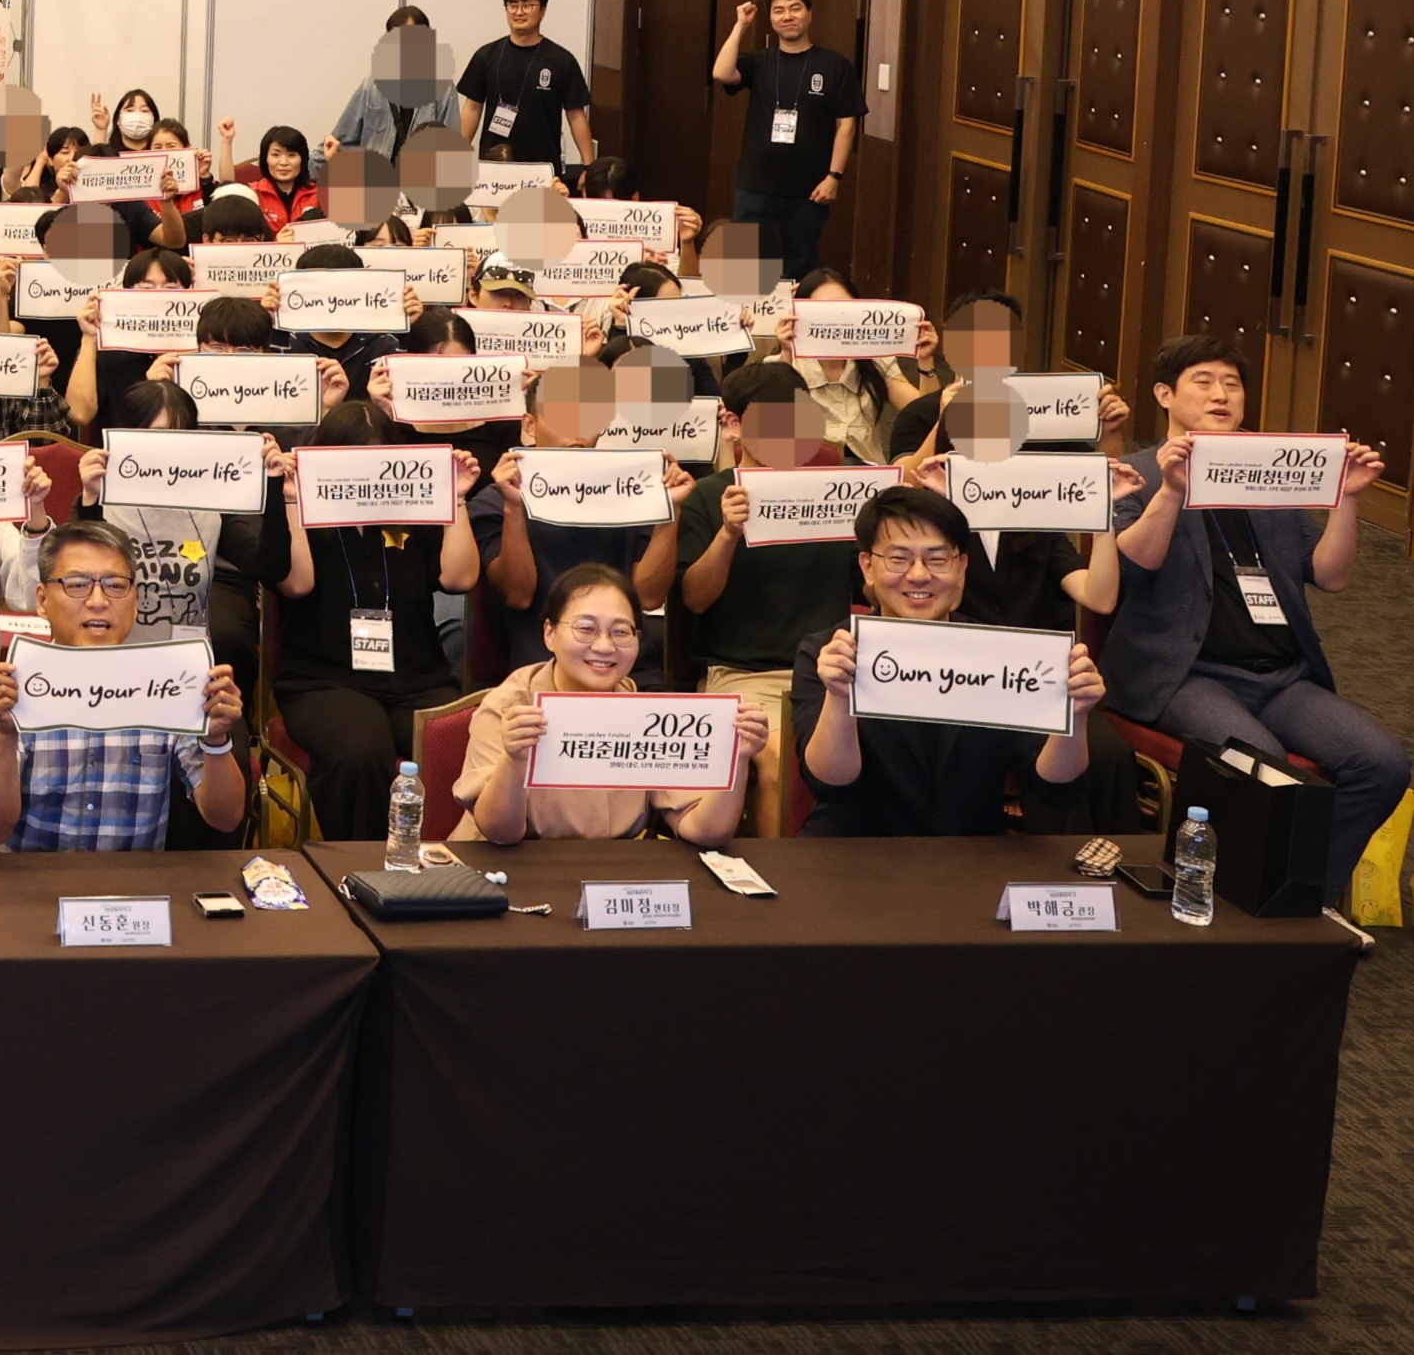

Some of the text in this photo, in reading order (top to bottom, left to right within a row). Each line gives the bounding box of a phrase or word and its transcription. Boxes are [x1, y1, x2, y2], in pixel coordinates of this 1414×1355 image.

[861, 310, 907, 326] 2026
[808, 327, 905, 341] 자립준비청년의 날
[462, 365, 511, 384] 2026
[189, 375, 299, 405] Own your life
[406, 383, 511, 401] 자립준비청년의 날
[1271, 448, 1327, 468] 2026
[379, 460, 433, 480] 2026
[1205, 468, 1324, 486] 자립준비청년의 날
[317, 482, 433, 500] 자립준비청년의 날
[962, 477, 1086, 509] Own your life
[1246, 593, 1275, 606] STAFF
[354, 637, 389, 652] STAFF
[871, 650, 1042, 695] Own your life
[24, 672, 182, 708] Own your life
[642, 713, 713, 738] 2026
[559, 740, 711, 761] 자립준비청년의 날
[604, 898, 651, 915] 김미정
[1027, 900, 1075, 917] 박해긍
[82, 914, 129, 932] 신동훈
